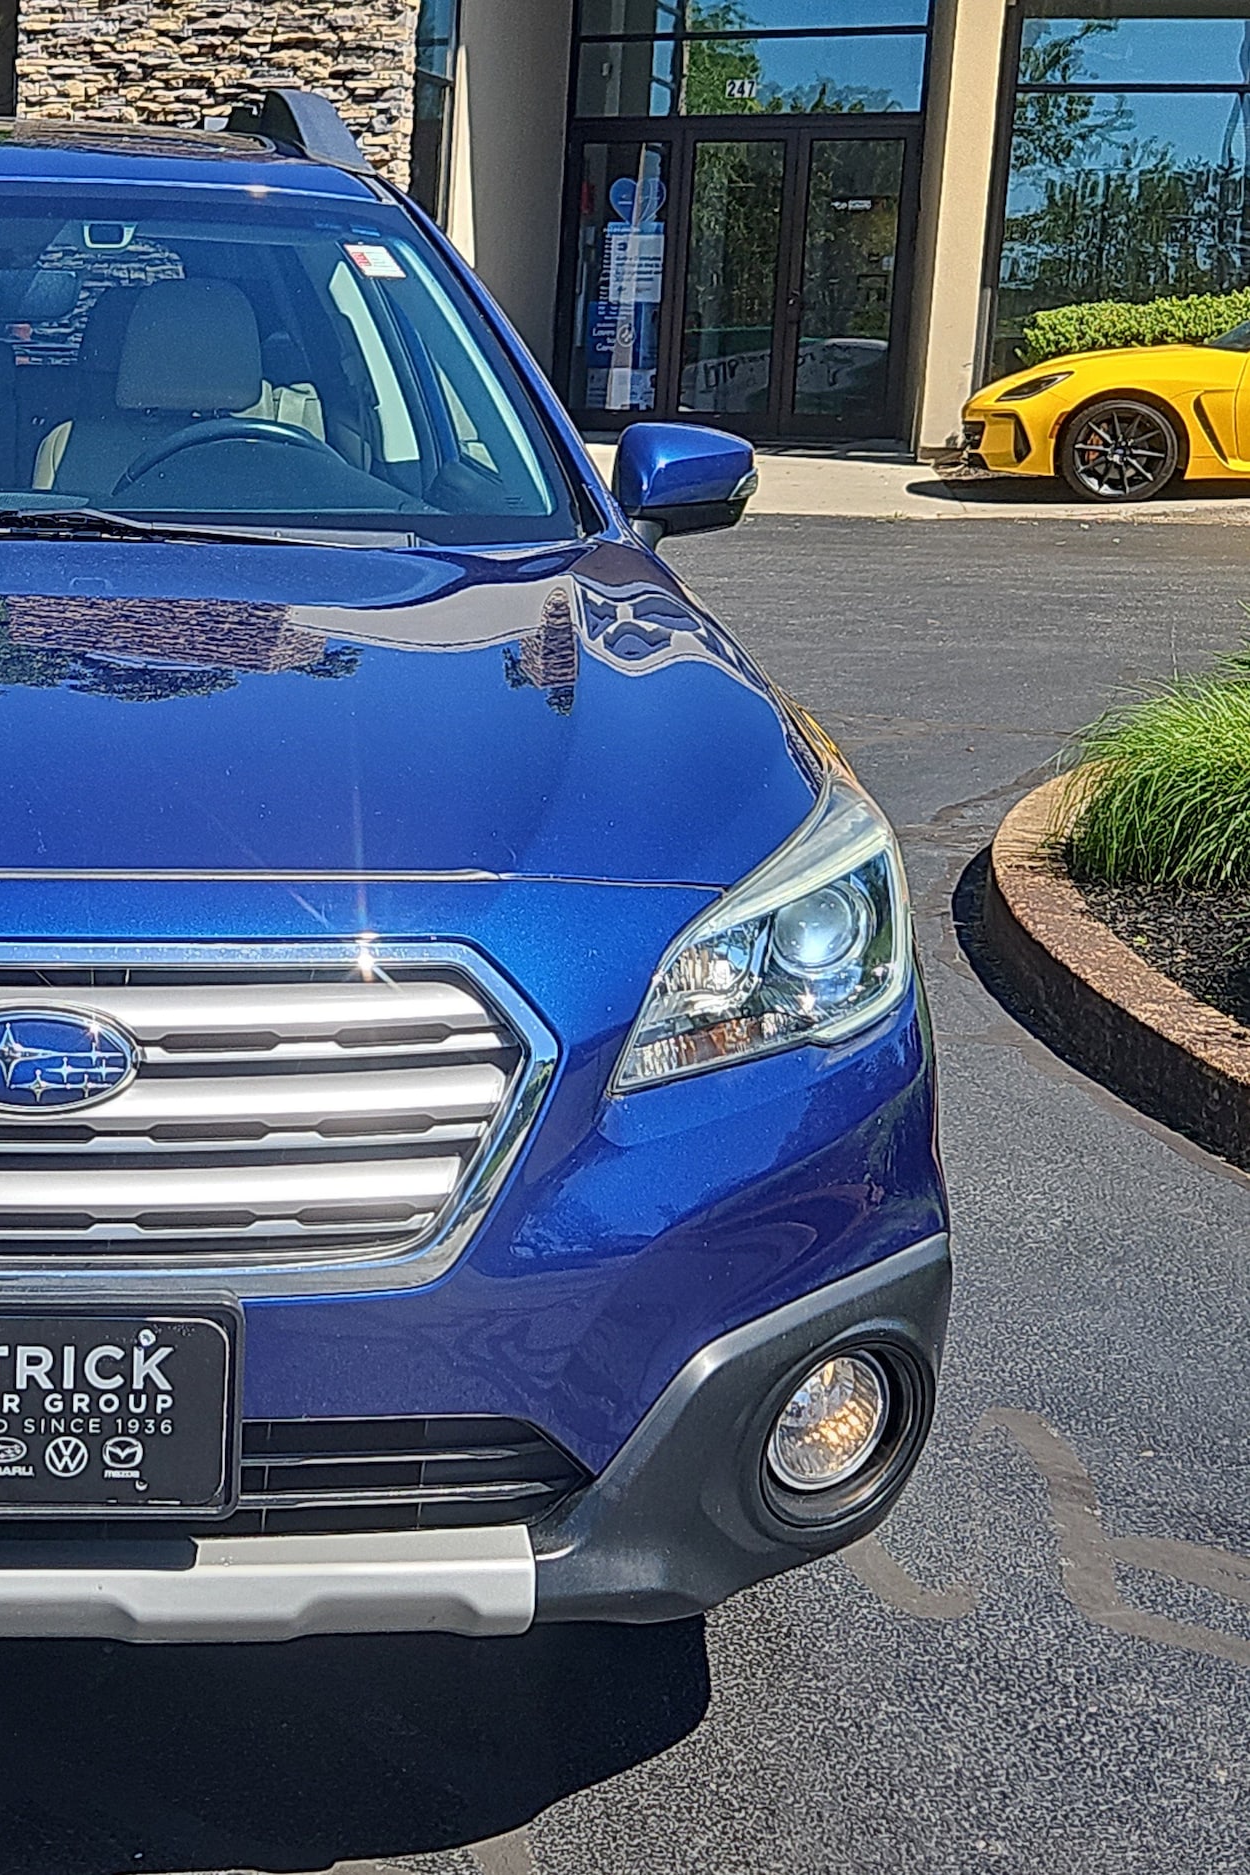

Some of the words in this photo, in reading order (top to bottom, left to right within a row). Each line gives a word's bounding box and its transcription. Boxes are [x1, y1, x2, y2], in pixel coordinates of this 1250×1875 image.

[727, 80, 755, 97] 247
[44, 1394, 174, 1414] GROUP
[23, 1417, 102, 1435] SINCE
[115, 1418, 173, 1435] 1936
